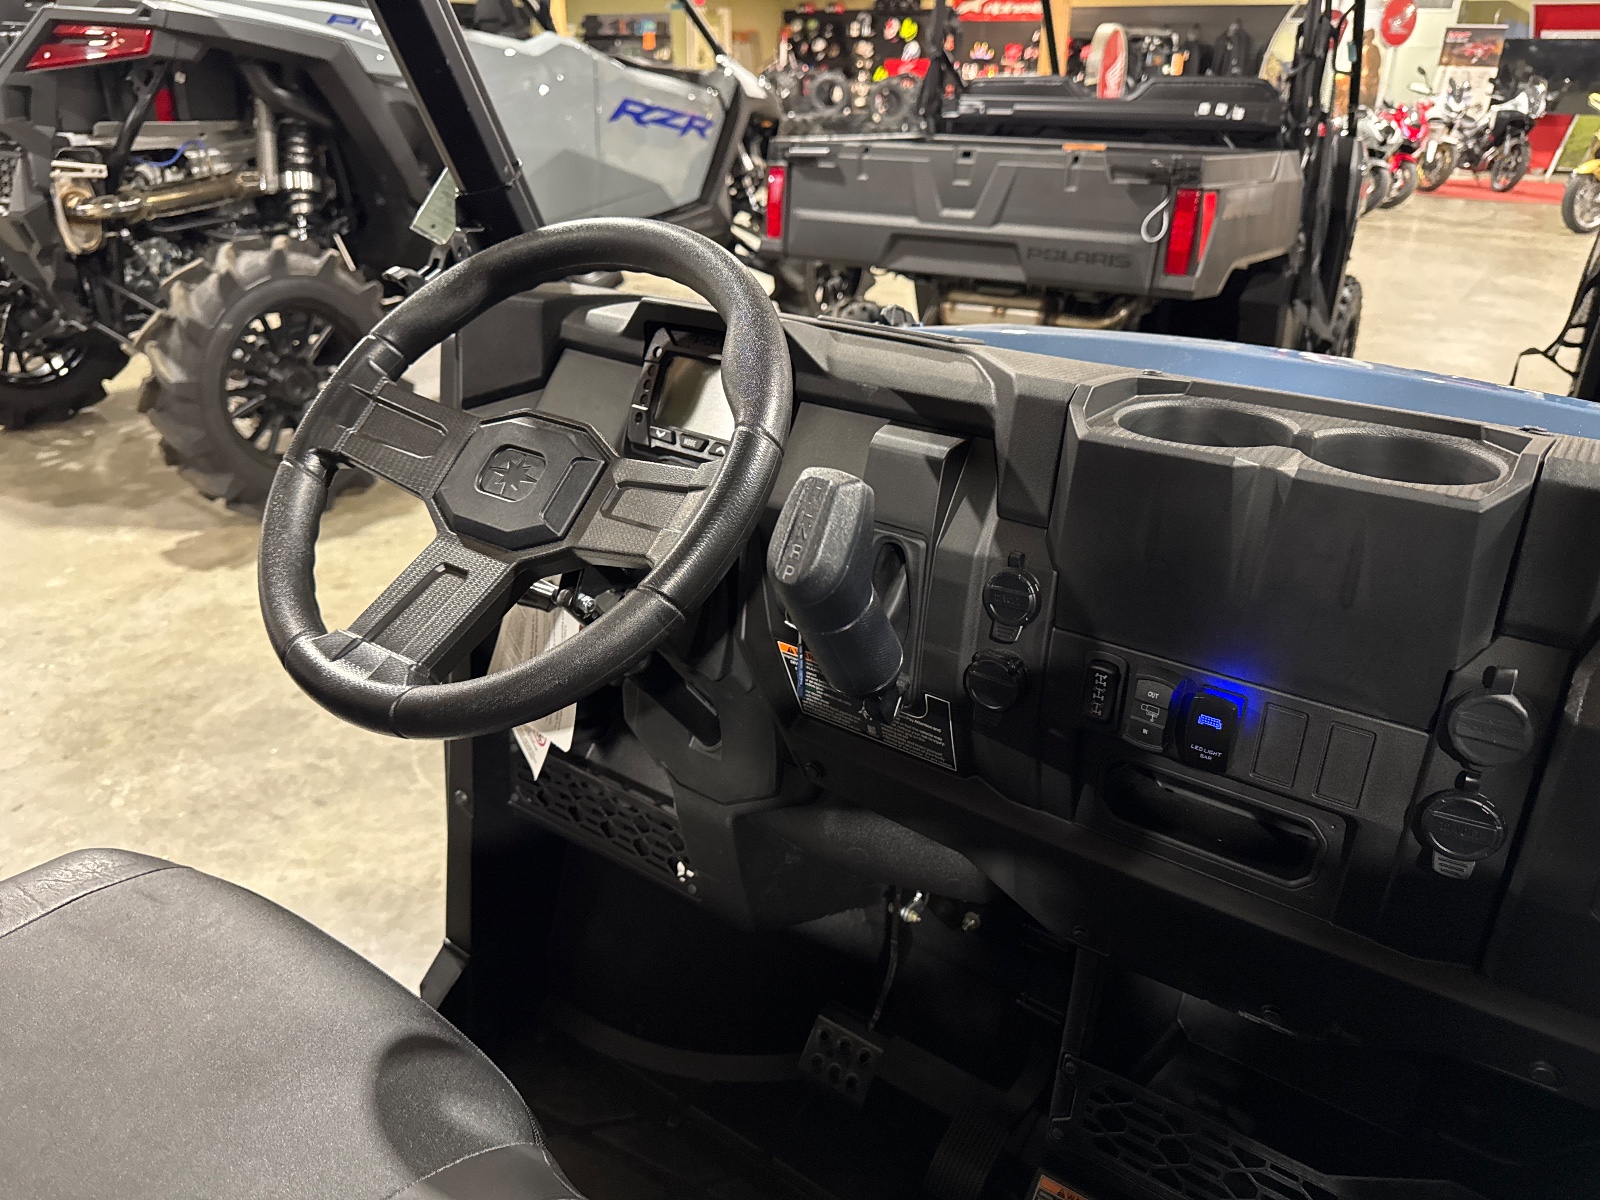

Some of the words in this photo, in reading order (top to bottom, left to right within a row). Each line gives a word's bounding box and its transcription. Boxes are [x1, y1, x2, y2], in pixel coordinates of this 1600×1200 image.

[607, 98, 713, 139] RZR
[1025, 247, 1133, 269] POLARIS
[790, 543, 803, 560] R
[782, 564, 795, 580] P
[1147, 691, 1159, 700] OUT
[1190, 743, 1203, 752] LED
[1203, 748, 1222, 757] LIGHT
